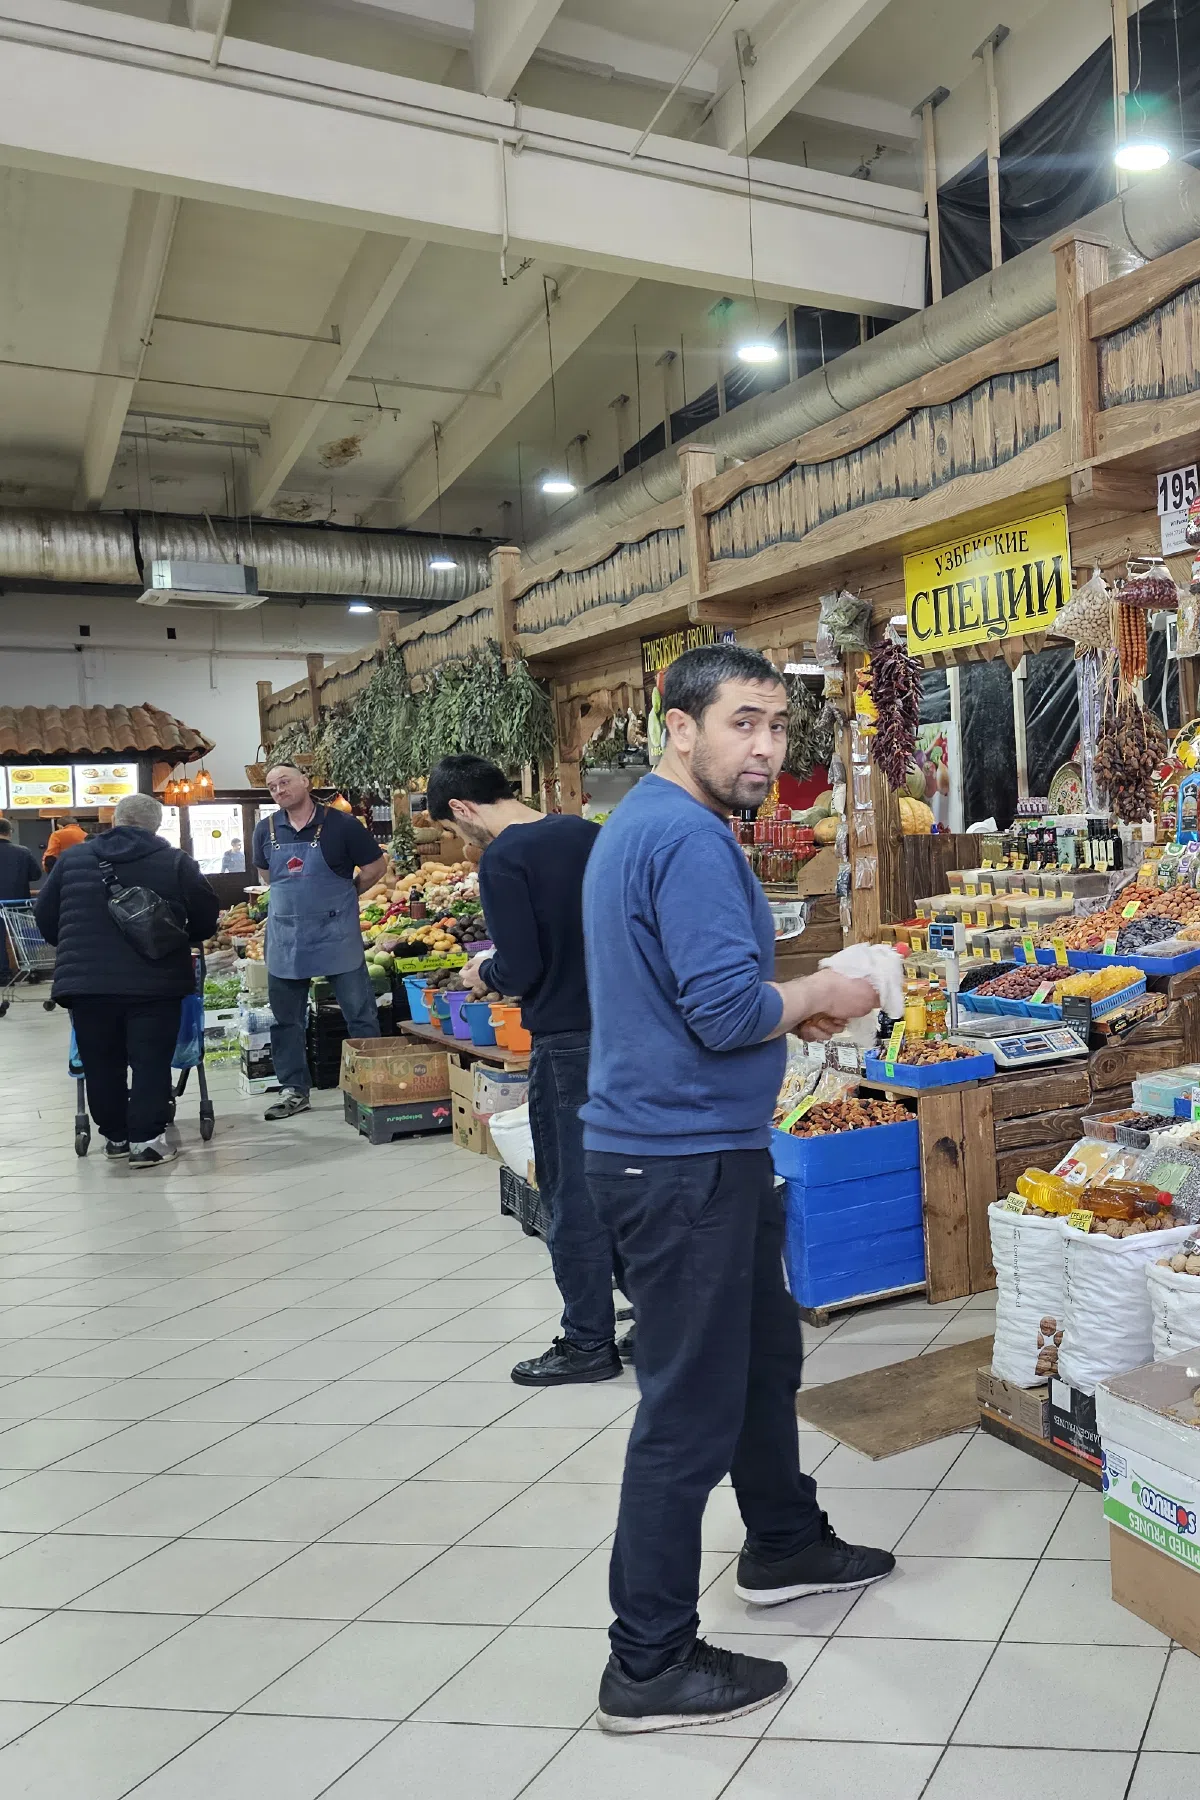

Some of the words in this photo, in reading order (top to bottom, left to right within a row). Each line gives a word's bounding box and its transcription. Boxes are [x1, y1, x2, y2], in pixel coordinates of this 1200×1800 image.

[1159, 468, 1197, 512] 195
[934, 530, 1029, 577] УЗБЕКСКИЕ
[911, 555, 1065, 641] СПЕЦИИ
[642, 632, 685, 673] ТАМБОВСКИЕ
[687, 624, 716, 651] ОВОЩИ
[412, 1076, 445, 1085] PRIMA
[412, 1084, 445, 1092] DONNA
[386, 1111, 423, 1122] belapple.ru
[1053, 1414, 1100, 1444] ARGENPRUNES
[1128, 1511, 1166, 1546] PRUNES
[1168, 1534, 1200, 1567] PITTED
